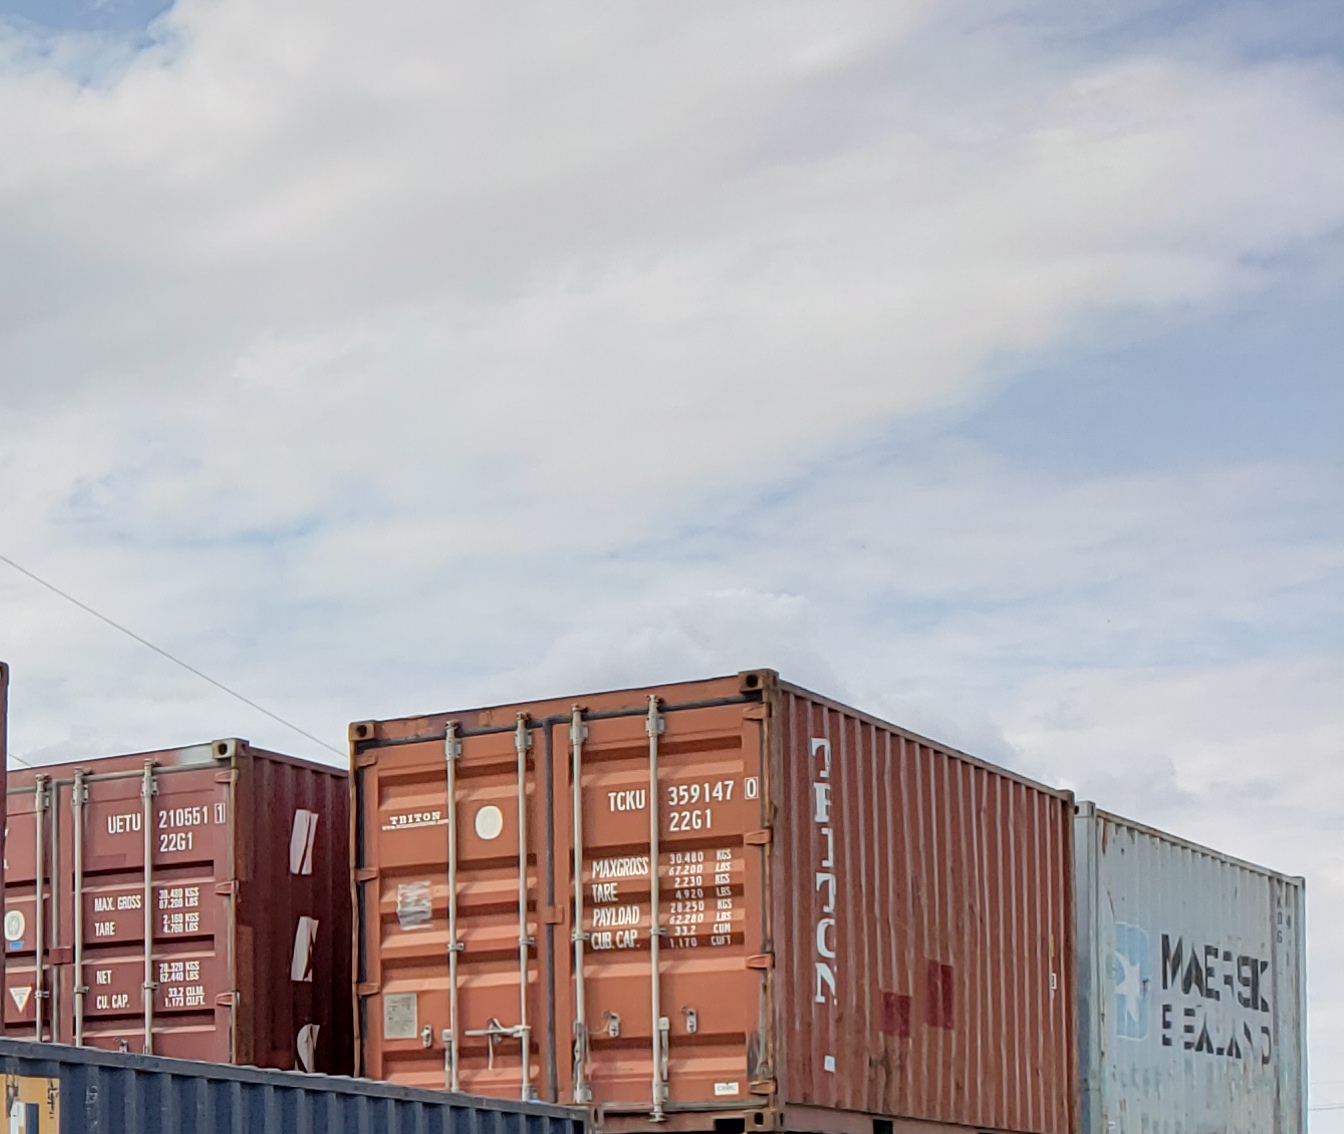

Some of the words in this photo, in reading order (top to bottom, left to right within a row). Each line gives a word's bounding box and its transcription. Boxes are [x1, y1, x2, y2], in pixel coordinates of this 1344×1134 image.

[608, 790, 646, 812] TCKU
[668, 780, 734, 806] 359147
[746, 778, 758, 799] 0
[108, 813, 142, 834] UETU
[159, 806, 209, 829] 210551
[390, 811, 441, 826] TRITON
[669, 809, 712, 832] 22G1
[160, 832, 193, 852] 22G1
[118, 895, 142, 910] GROSS
[592, 882, 619, 903] TARE
[593, 905, 640, 927] PAYLOAD
[95, 922, 115, 937] TARE
[97, 970, 112, 985] NET
[1162, 1004, 1272, 1066] SEAAD
